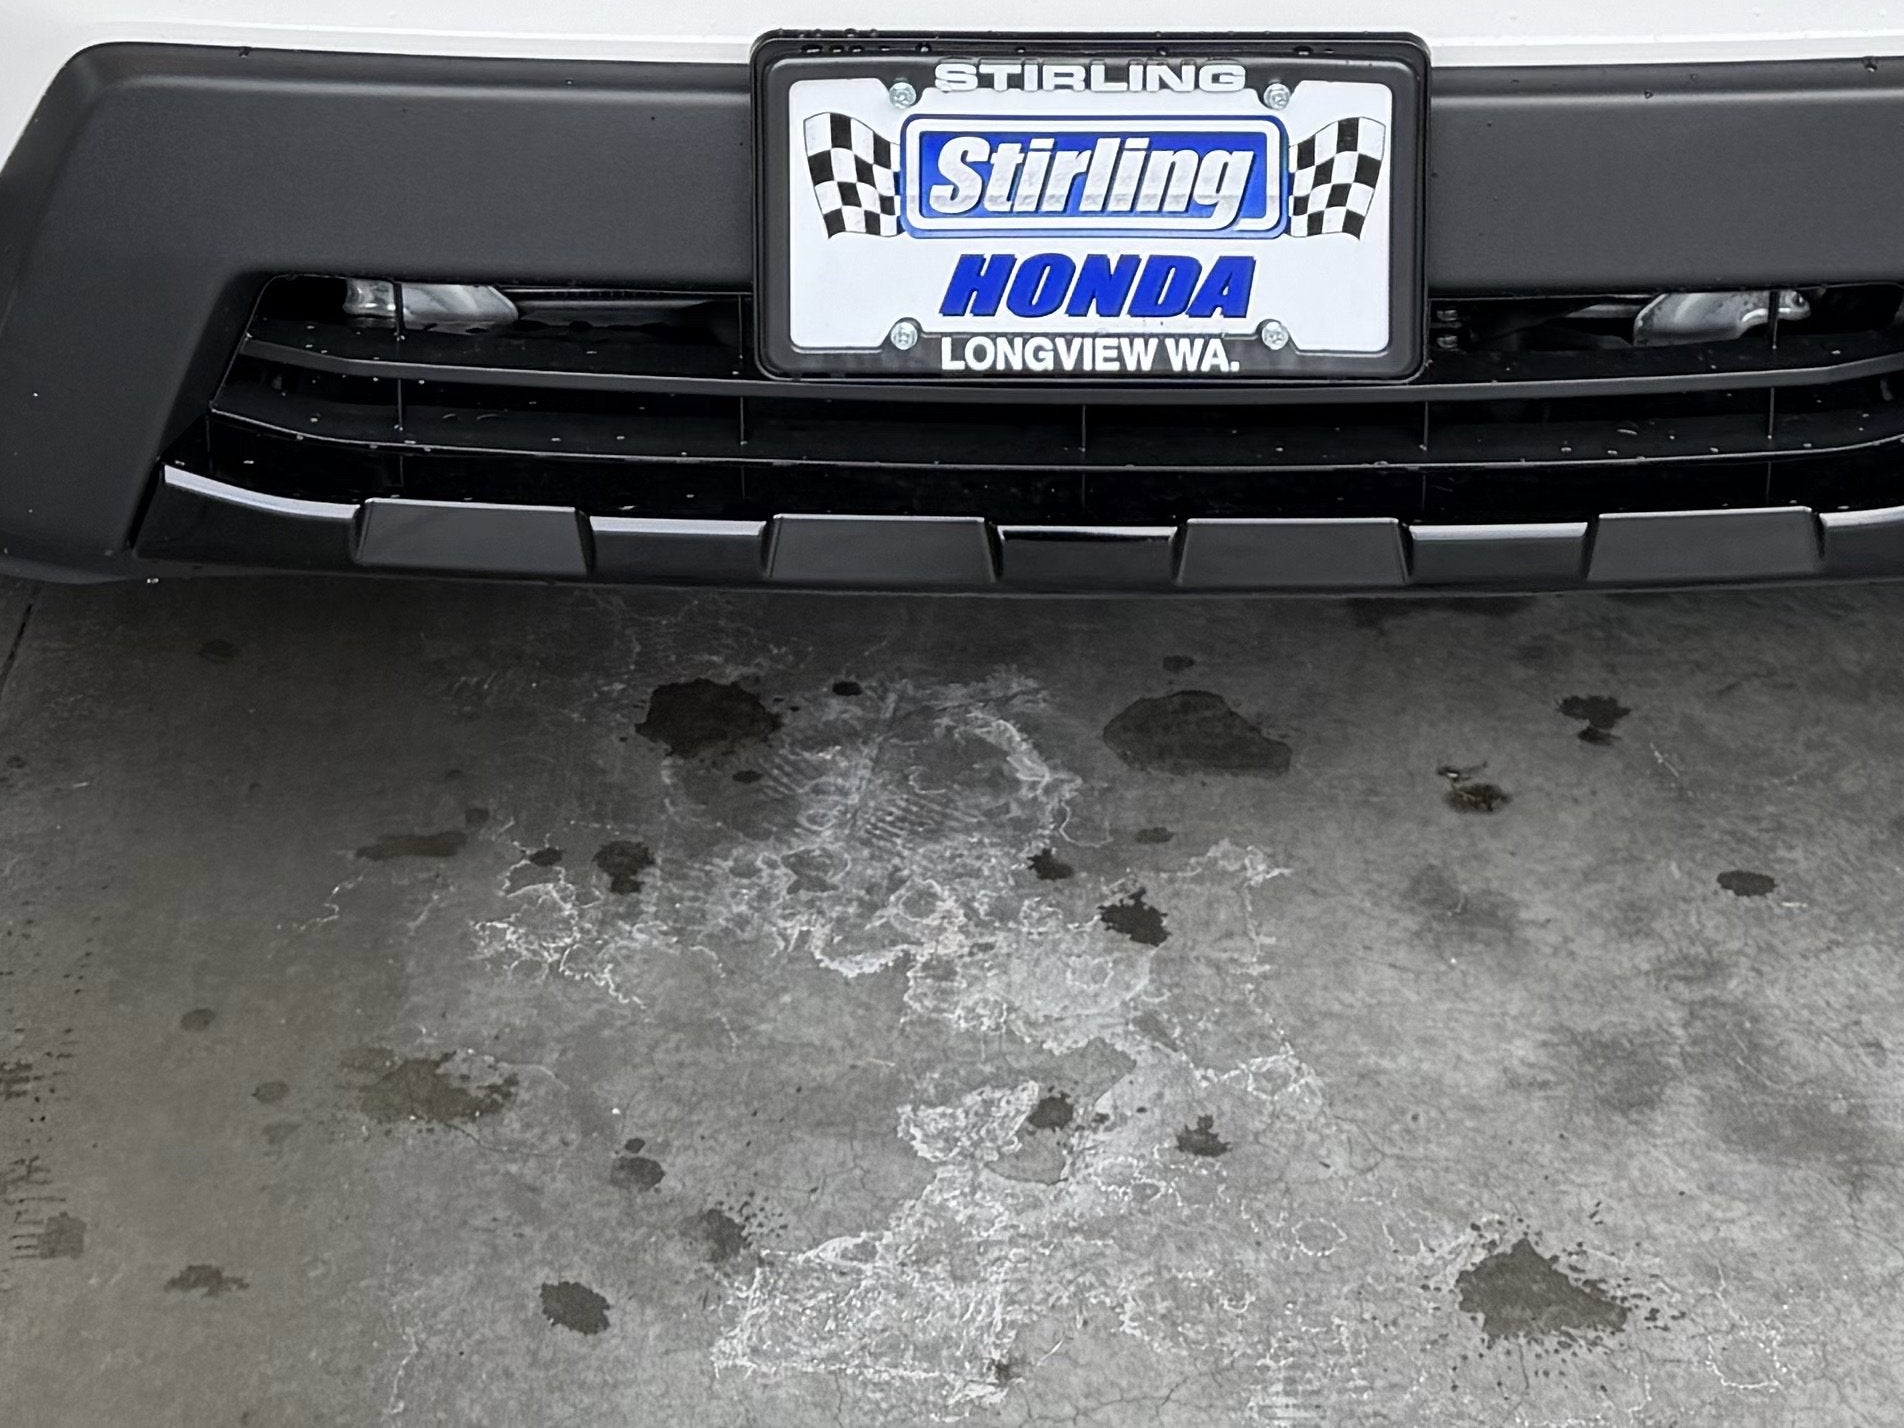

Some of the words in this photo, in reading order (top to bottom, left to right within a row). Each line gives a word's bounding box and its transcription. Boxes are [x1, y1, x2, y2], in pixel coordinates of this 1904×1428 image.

[934, 60, 1247, 93] STIRLING
[928, 135, 1255, 232] Stirling
[938, 252, 1257, 319] HONDA
[940, 336, 1159, 373] LONGVIEW
[1164, 337, 1241, 373] WA.
